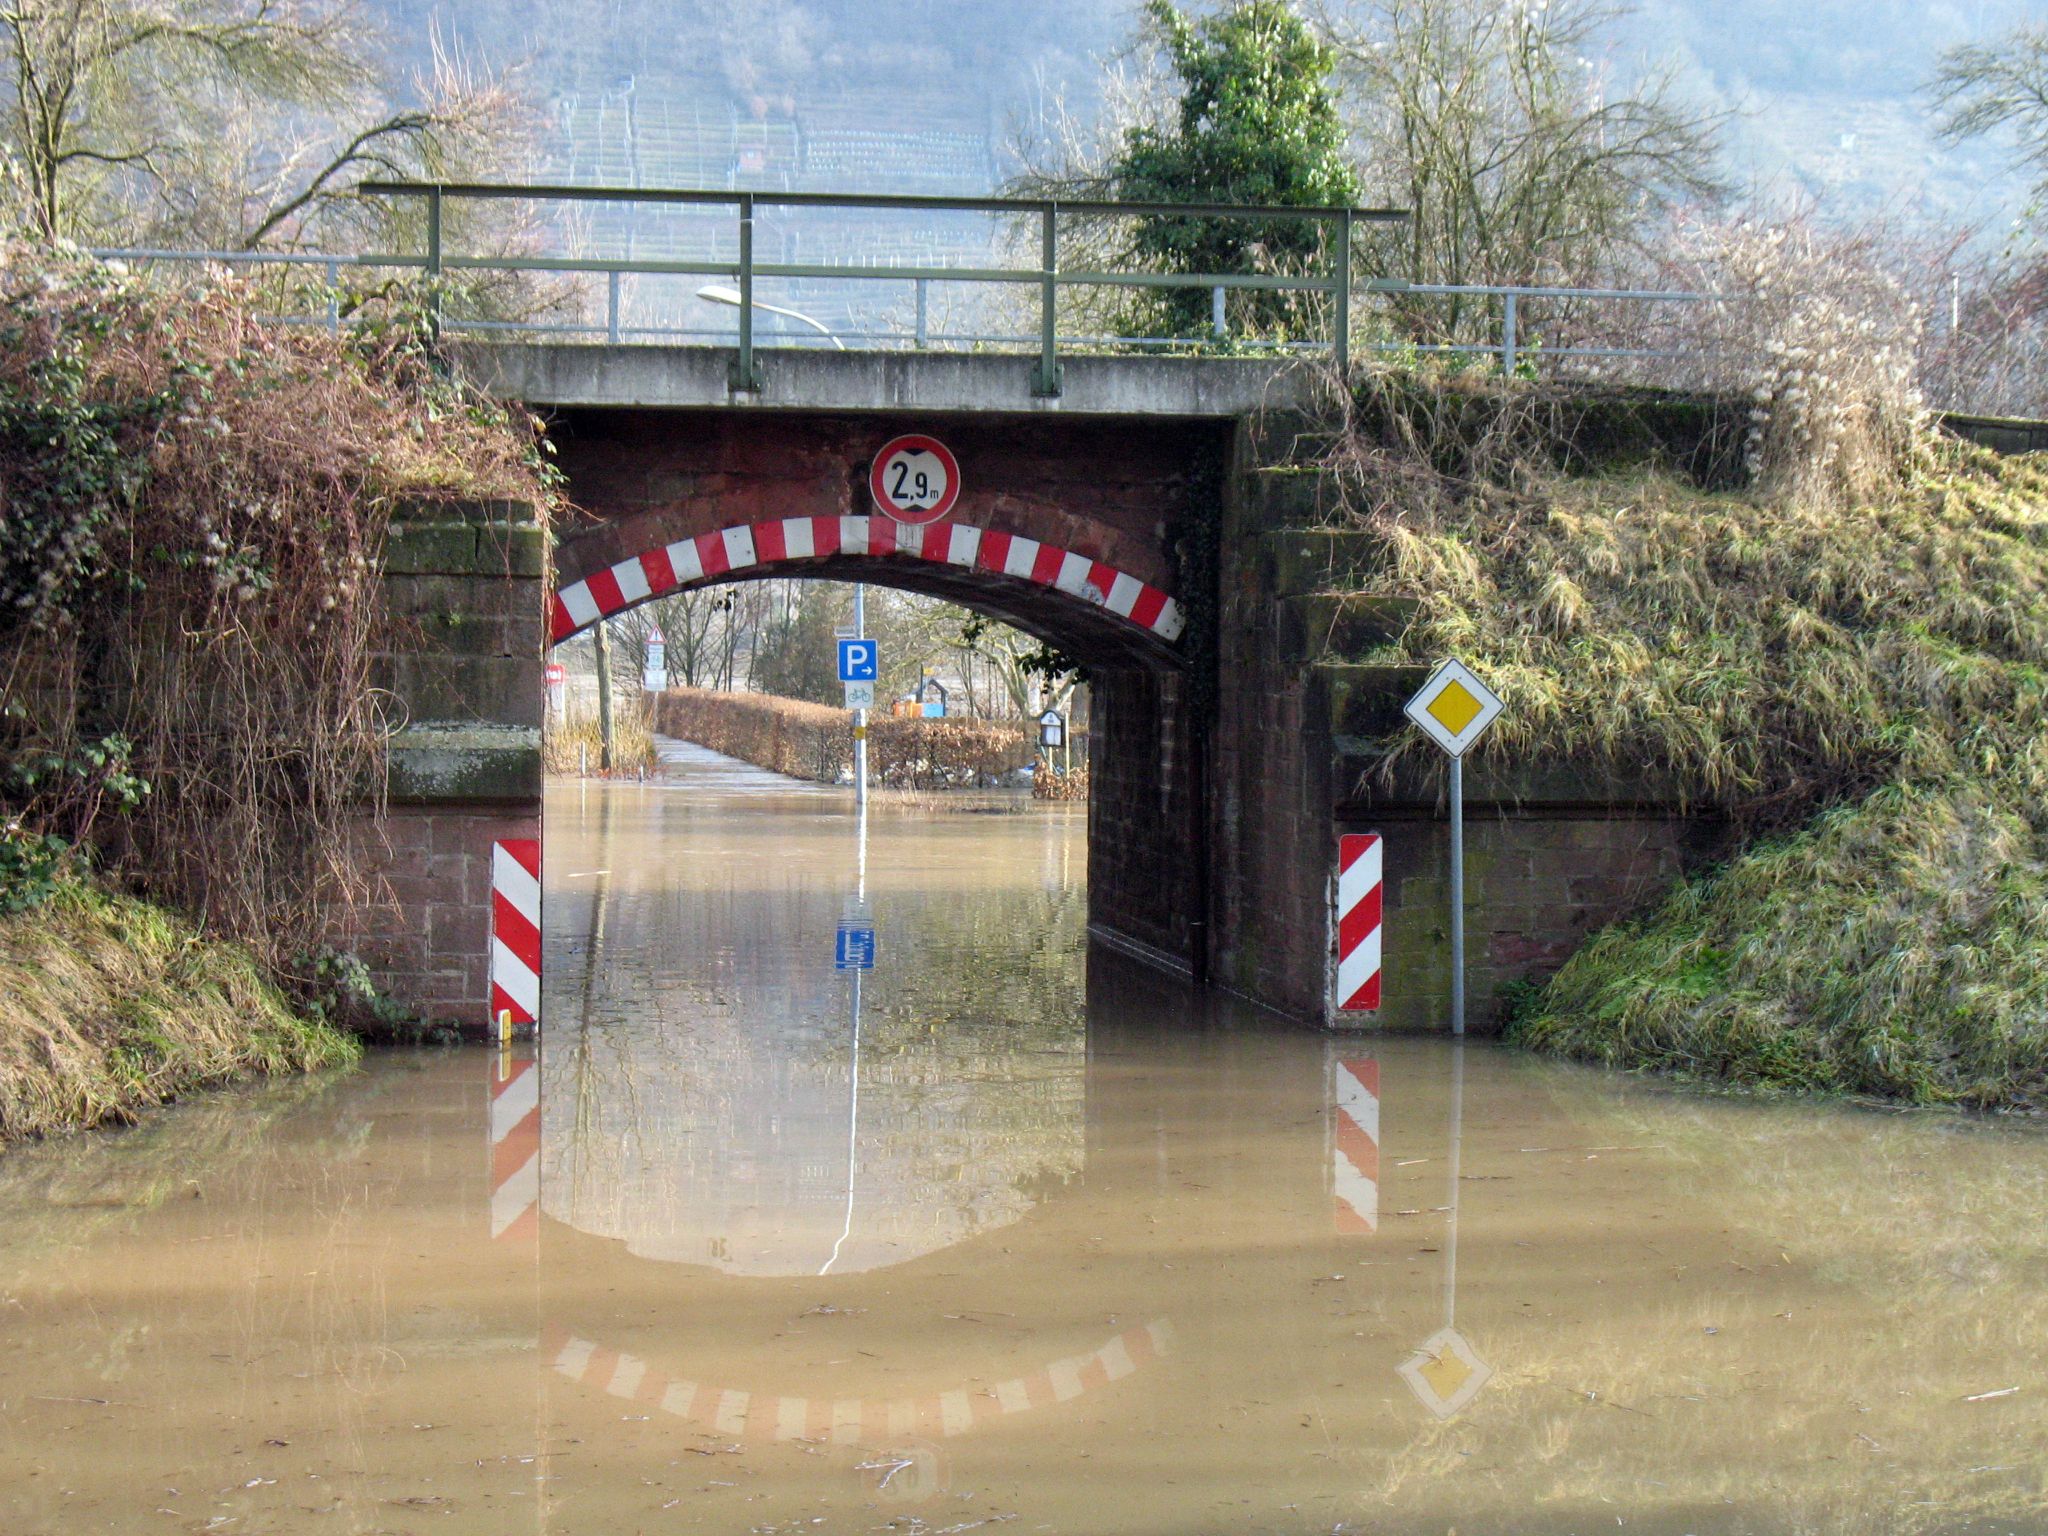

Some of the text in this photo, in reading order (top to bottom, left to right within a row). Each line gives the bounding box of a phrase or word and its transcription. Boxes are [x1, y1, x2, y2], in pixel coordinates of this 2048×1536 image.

[892, 461, 939, 500] 2,9 m
[847, 645, 868, 676] P
